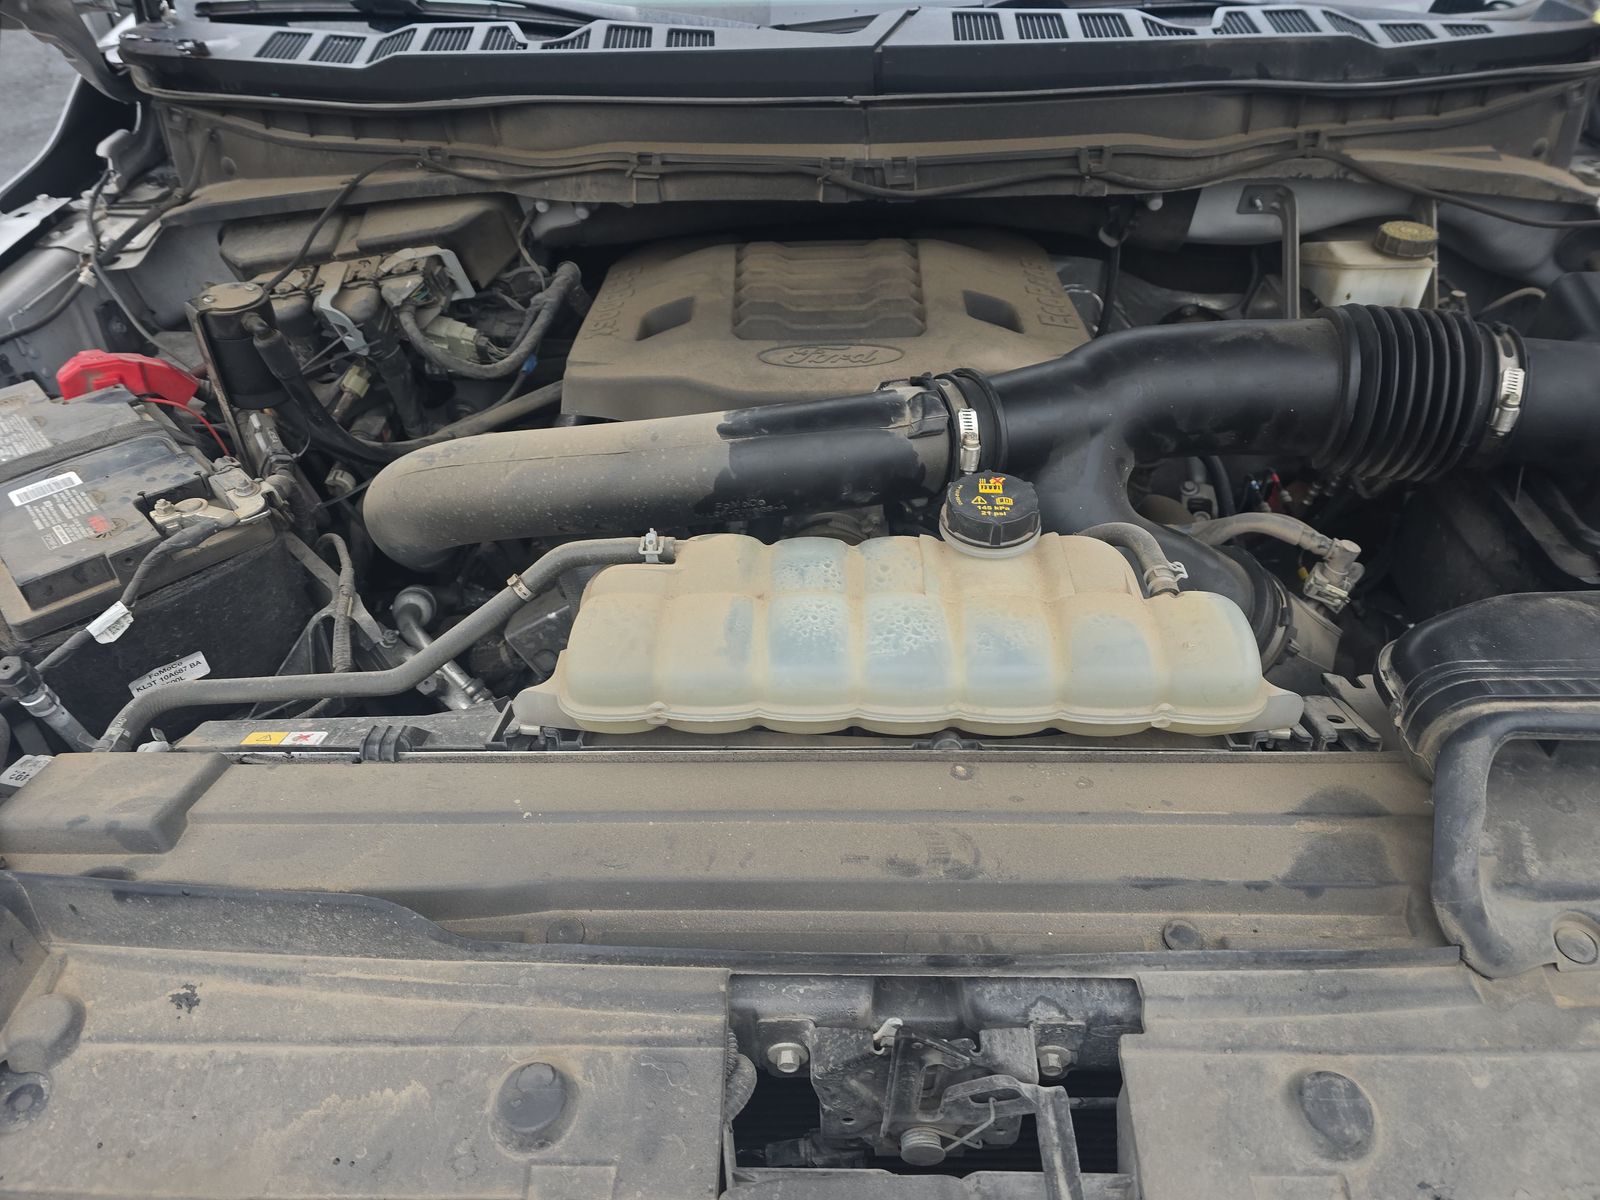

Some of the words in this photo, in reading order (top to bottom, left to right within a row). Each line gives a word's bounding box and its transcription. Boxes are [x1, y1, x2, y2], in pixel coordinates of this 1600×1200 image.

[784, 346, 879, 365] Ford
[148, 661, 183, 679] FoMoCo
[189, 660, 202, 669] BA
